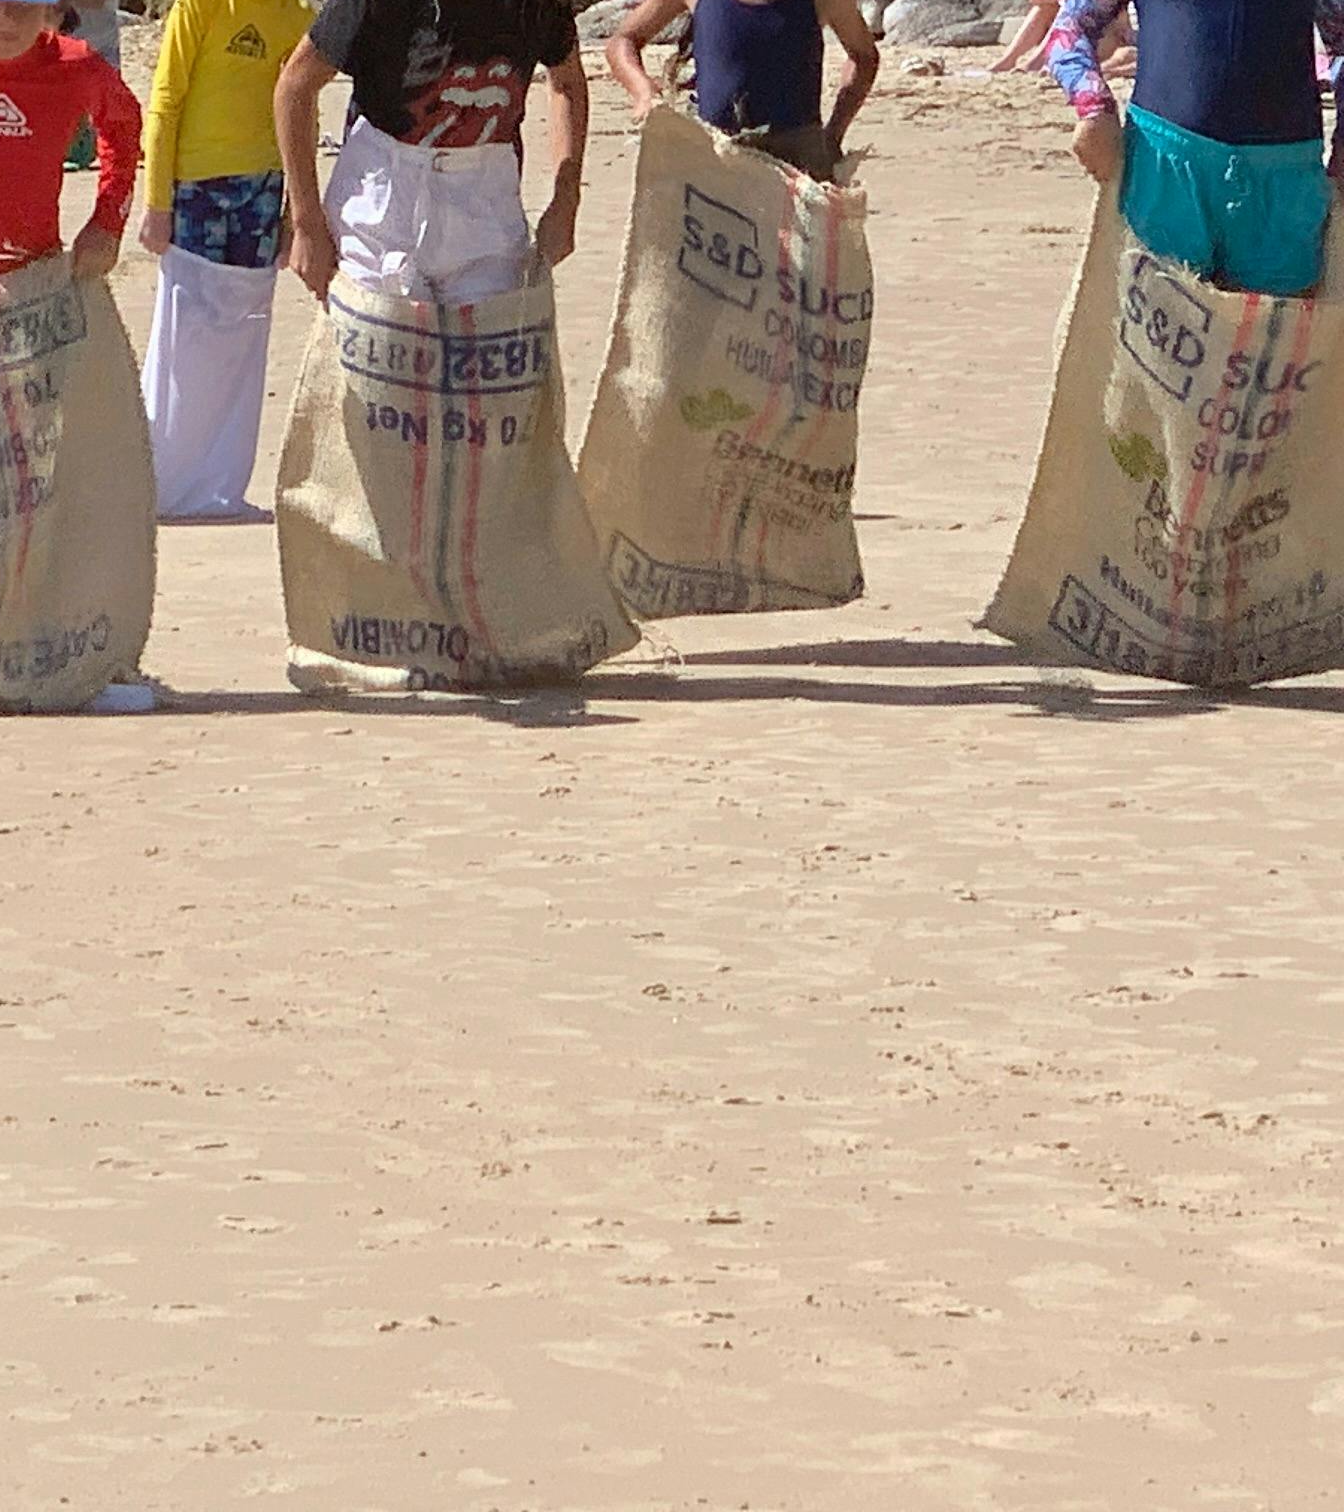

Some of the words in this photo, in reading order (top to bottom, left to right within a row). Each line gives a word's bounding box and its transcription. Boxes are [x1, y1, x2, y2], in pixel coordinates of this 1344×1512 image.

[683, 214, 765, 280] S&D
[1126, 284, 1206, 368] S&D
[366, 402, 429, 445] Net
